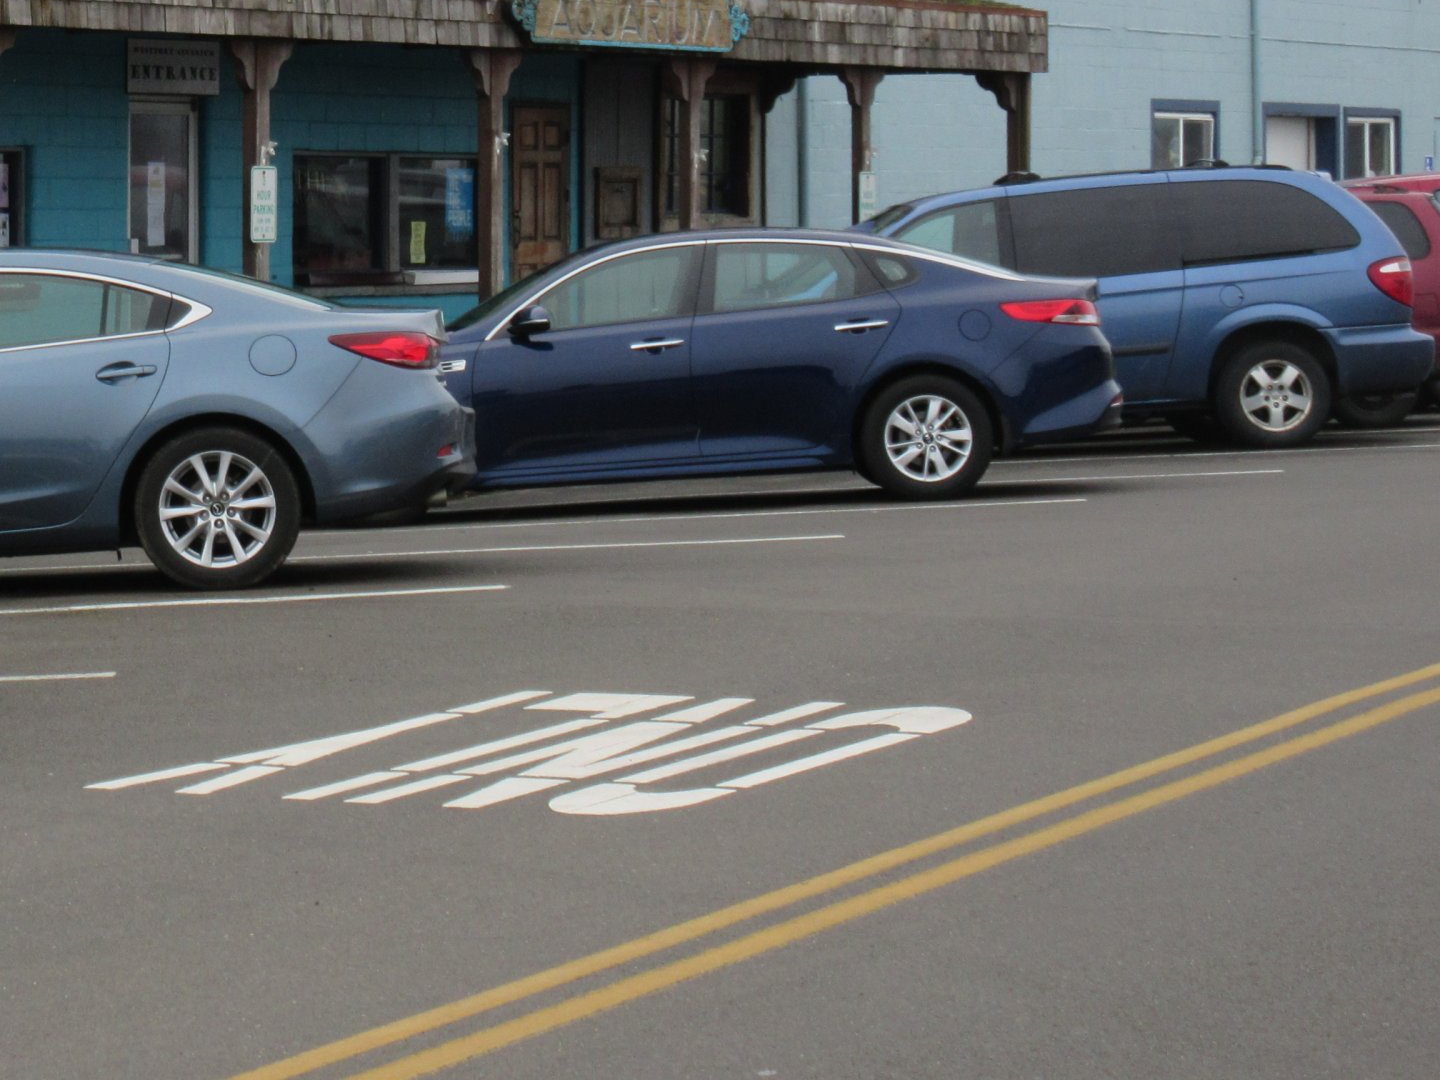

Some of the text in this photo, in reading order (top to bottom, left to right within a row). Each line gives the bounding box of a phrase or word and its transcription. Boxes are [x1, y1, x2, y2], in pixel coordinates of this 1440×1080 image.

[130, 64, 217, 82] ENTRANCE
[253, 204, 275, 216] PARKING
[83, 689, 972, 816] ONLY
